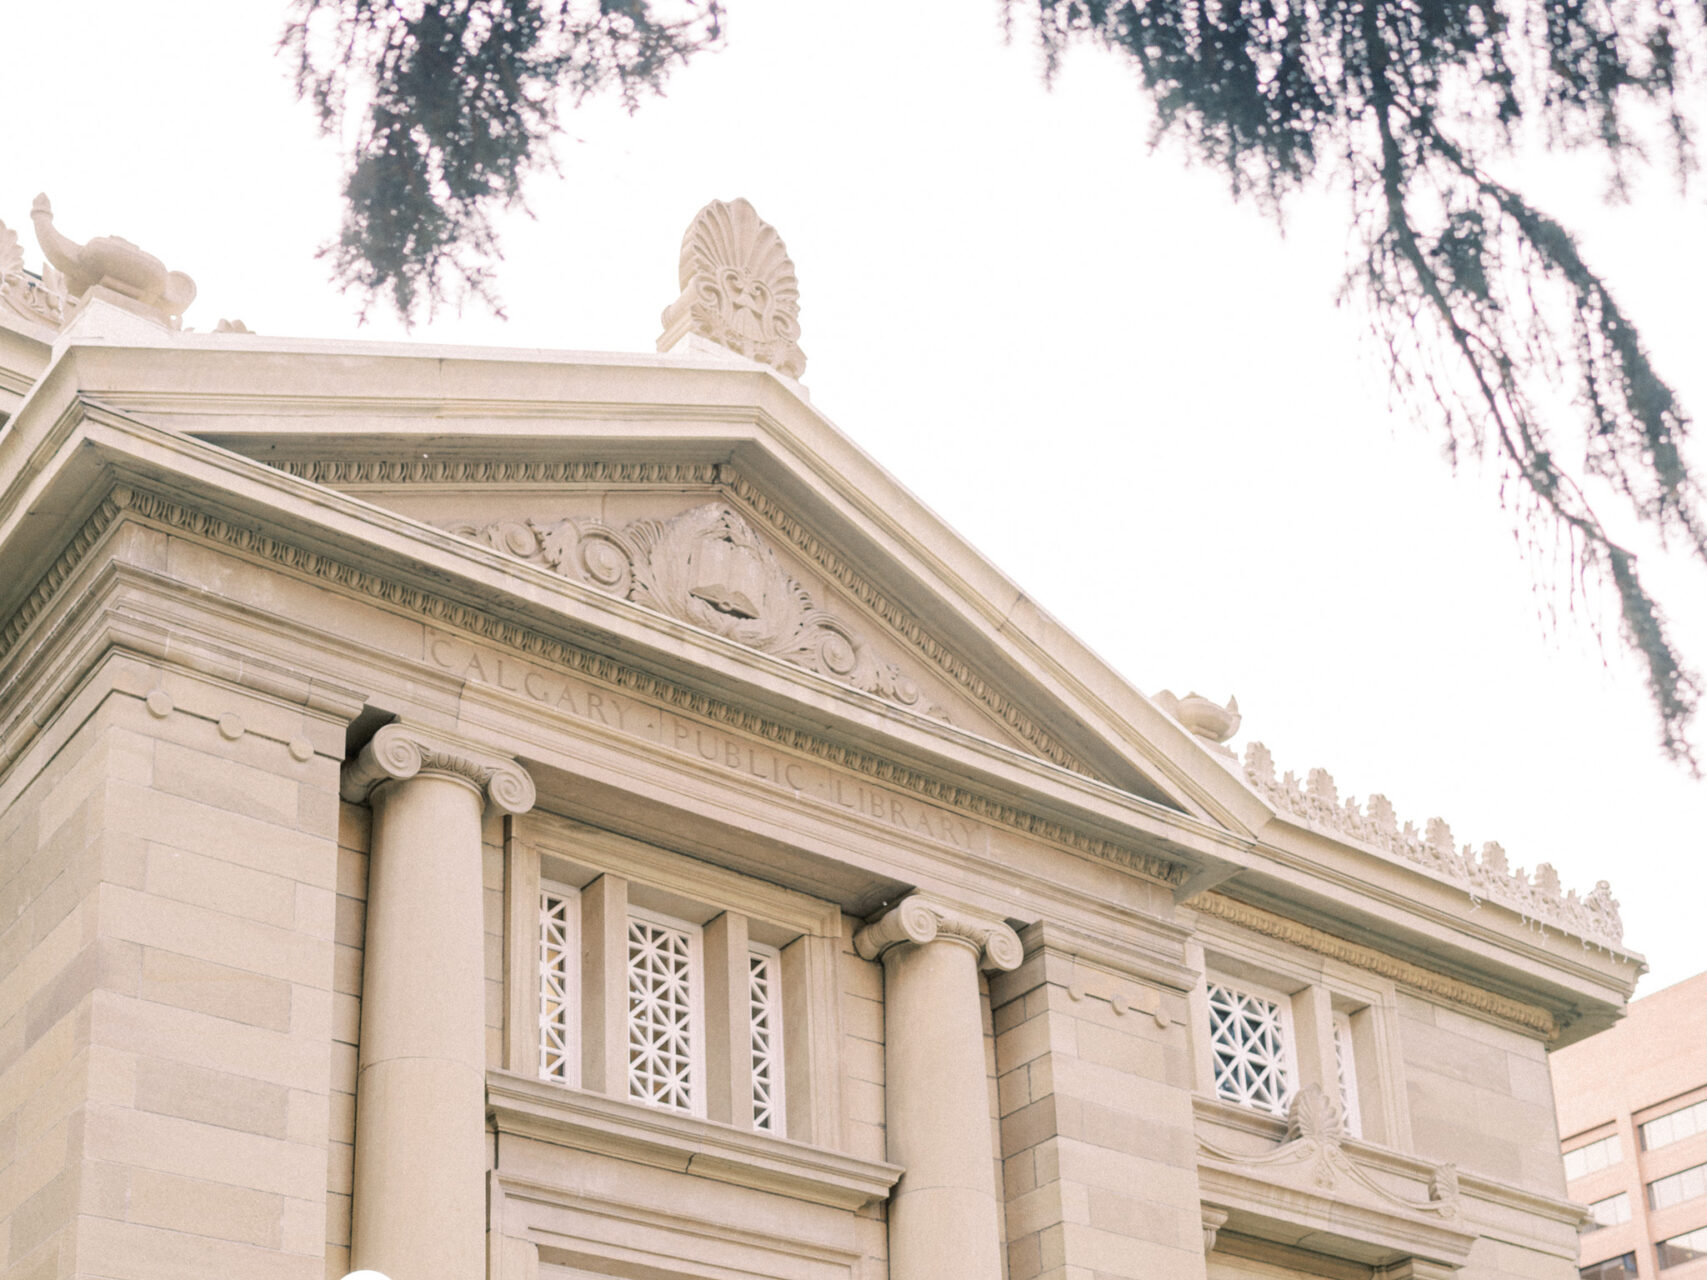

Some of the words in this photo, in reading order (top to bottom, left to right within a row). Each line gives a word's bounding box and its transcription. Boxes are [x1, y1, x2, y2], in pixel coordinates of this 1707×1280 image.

[430, 639, 634, 731] CALGARY
[673, 717, 804, 791] PUBLIC
[835, 779, 982, 850] LIBRARY
